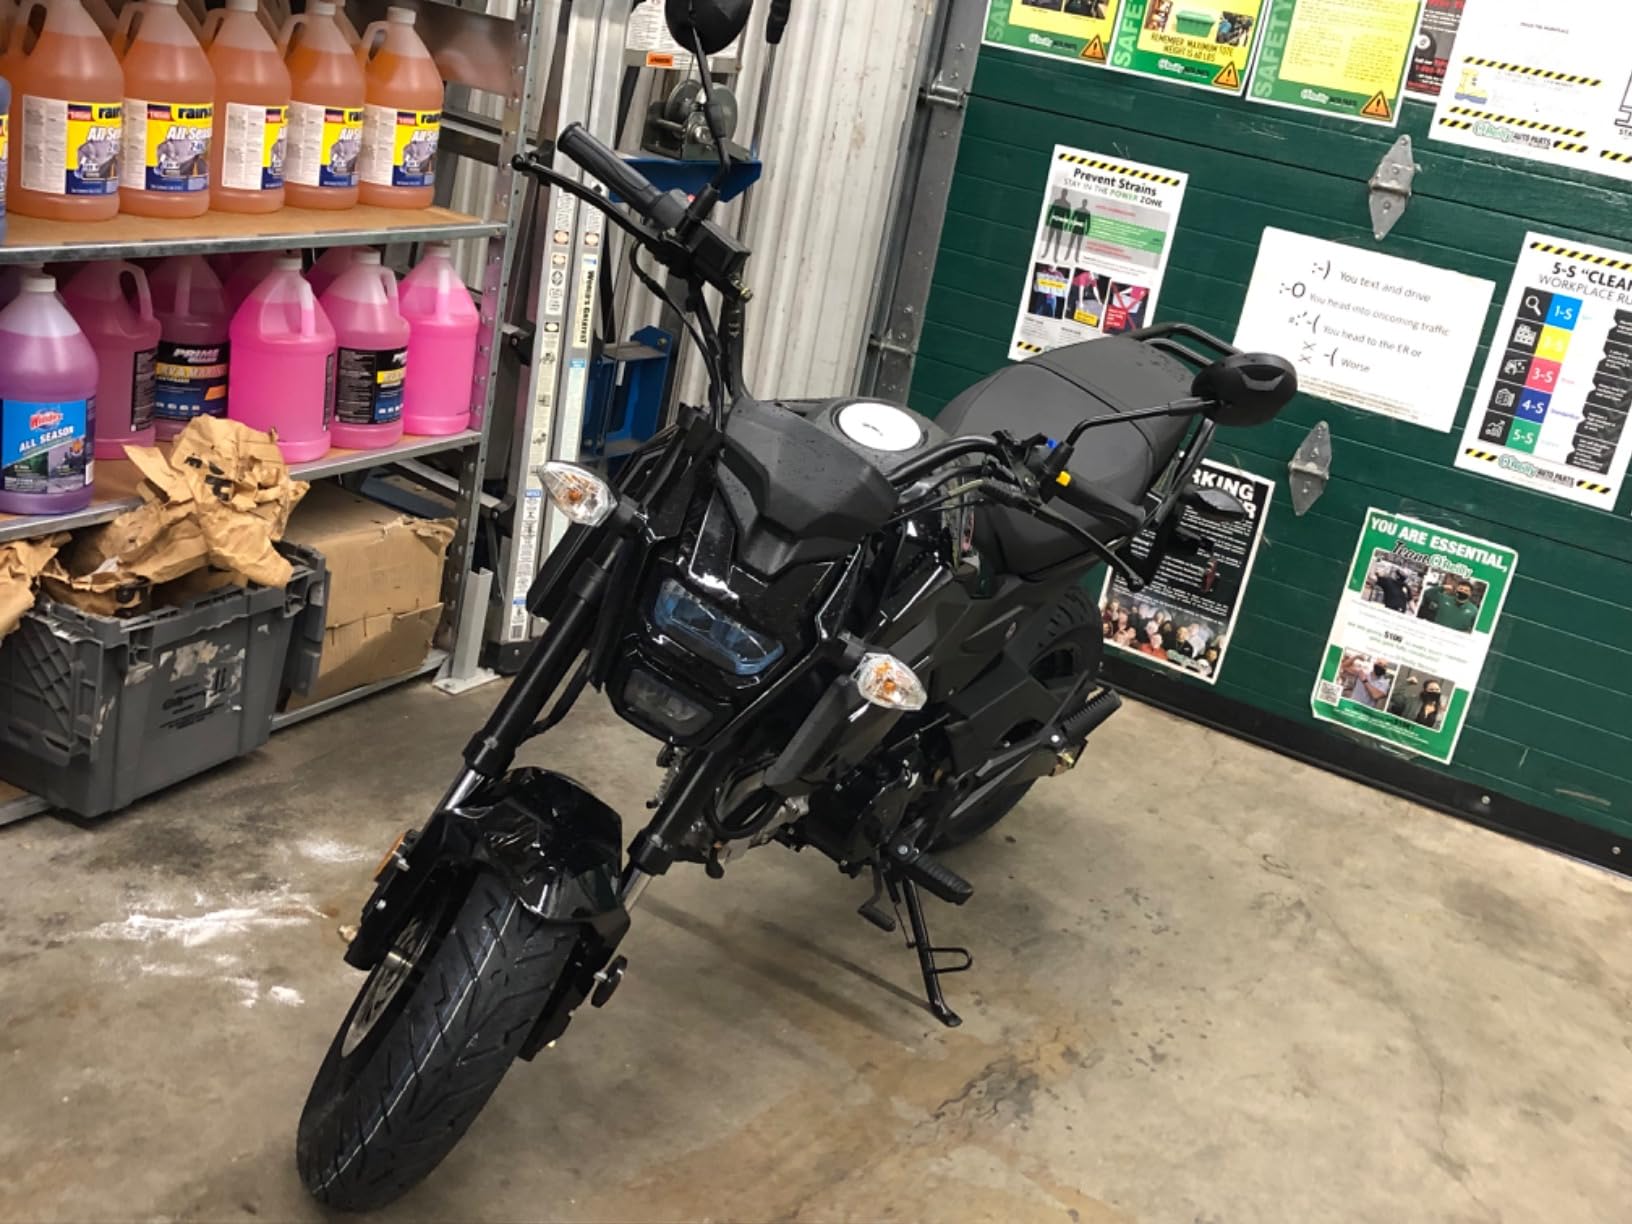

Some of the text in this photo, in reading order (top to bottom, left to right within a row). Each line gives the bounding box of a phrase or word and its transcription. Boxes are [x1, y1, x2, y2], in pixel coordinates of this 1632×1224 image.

[1113, 0, 1144, 68] SAFE
[1064, 178, 1082, 189] STAY
[1109, 188, 1138, 201] POWER
[1139, 195, 1163, 208] ZONE
[1073, 168, 1157, 197] Prevent Strains
[1552, 262, 1577, 278] 5-S
[1340, 271, 1358, 285] You
[1360, 277, 1380, 290] text
[1382, 283, 1403, 297] and
[1404, 288, 1431, 303] drive
[1538, 274, 1615, 301] WORKPLACE
[1310, 292, 1326, 305] You
[1327, 297, 1351, 311] head
[1352, 303, 1371, 317] into
[1372, 310, 1420, 331] oncoming
[1421, 321, 1450, 337] traffic
[1554, 305, 1574, 320] 1-S
[1323, 325, 1340, 337] You
[1341, 329, 1365, 343] head
[1367, 336, 1377, 347] to
[1379, 338, 1395, 350] the
[1397, 343, 1410, 354] ER
[1411, 349, 1422, 358] or
[1341, 357, 1371, 373] Worse
[1531, 367, 1554, 384] 3-S
[1521, 399, 1545, 415] 4-S
[19, 425, 74, 452] ALL SEASON
[1512, 429, 1535, 445] 5-S
[1371, 516, 1508, 573] YOU ARE ESSENTIAL,
[1392, 539, 1430, 565] Team
